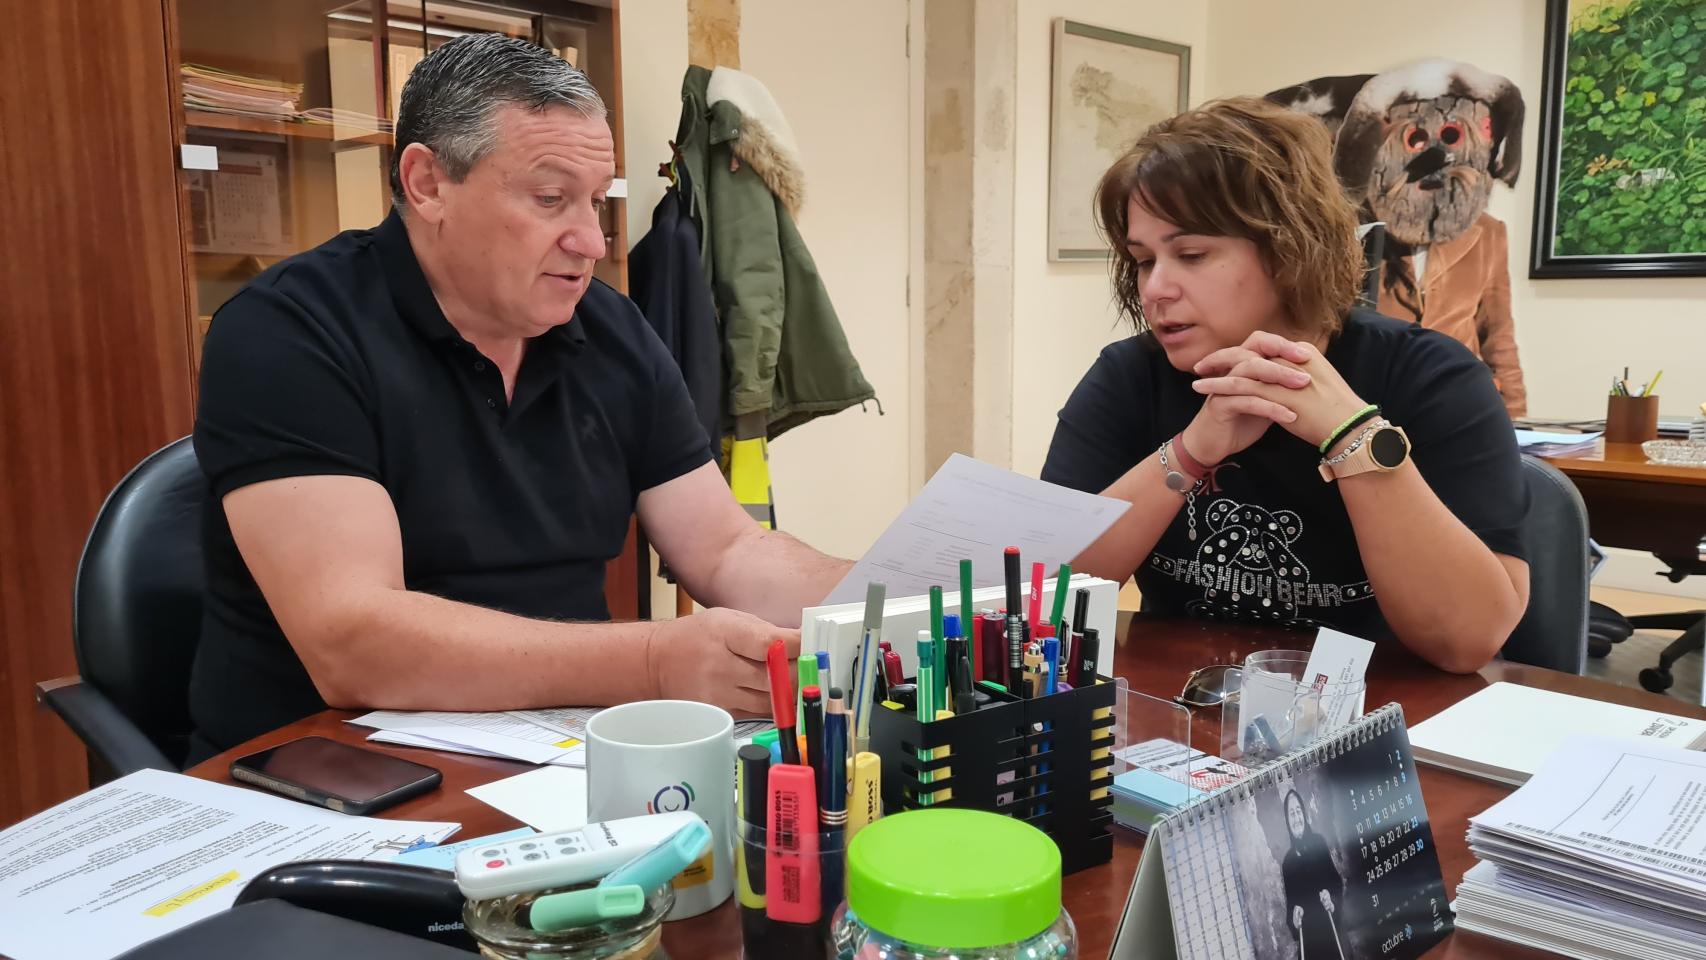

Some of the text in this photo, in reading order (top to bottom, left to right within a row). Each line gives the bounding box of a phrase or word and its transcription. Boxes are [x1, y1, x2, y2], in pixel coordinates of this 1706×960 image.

[1277, 578, 1342, 607] BEAR
[1395, 749, 1401, 761] 2
[1351, 771, 1406, 811] 3 4 5 6 7 8 9
[1355, 793, 1413, 835] 10 11 12 13 14 15 16
[1361, 815, 1419, 859] 17 18 19 20 21 22 23
[1366, 838, 1424, 884] 24 25 26 27 28 29 30
[1371, 894, 1380, 907] 31
[1381, 931, 1405, 954] octubre
